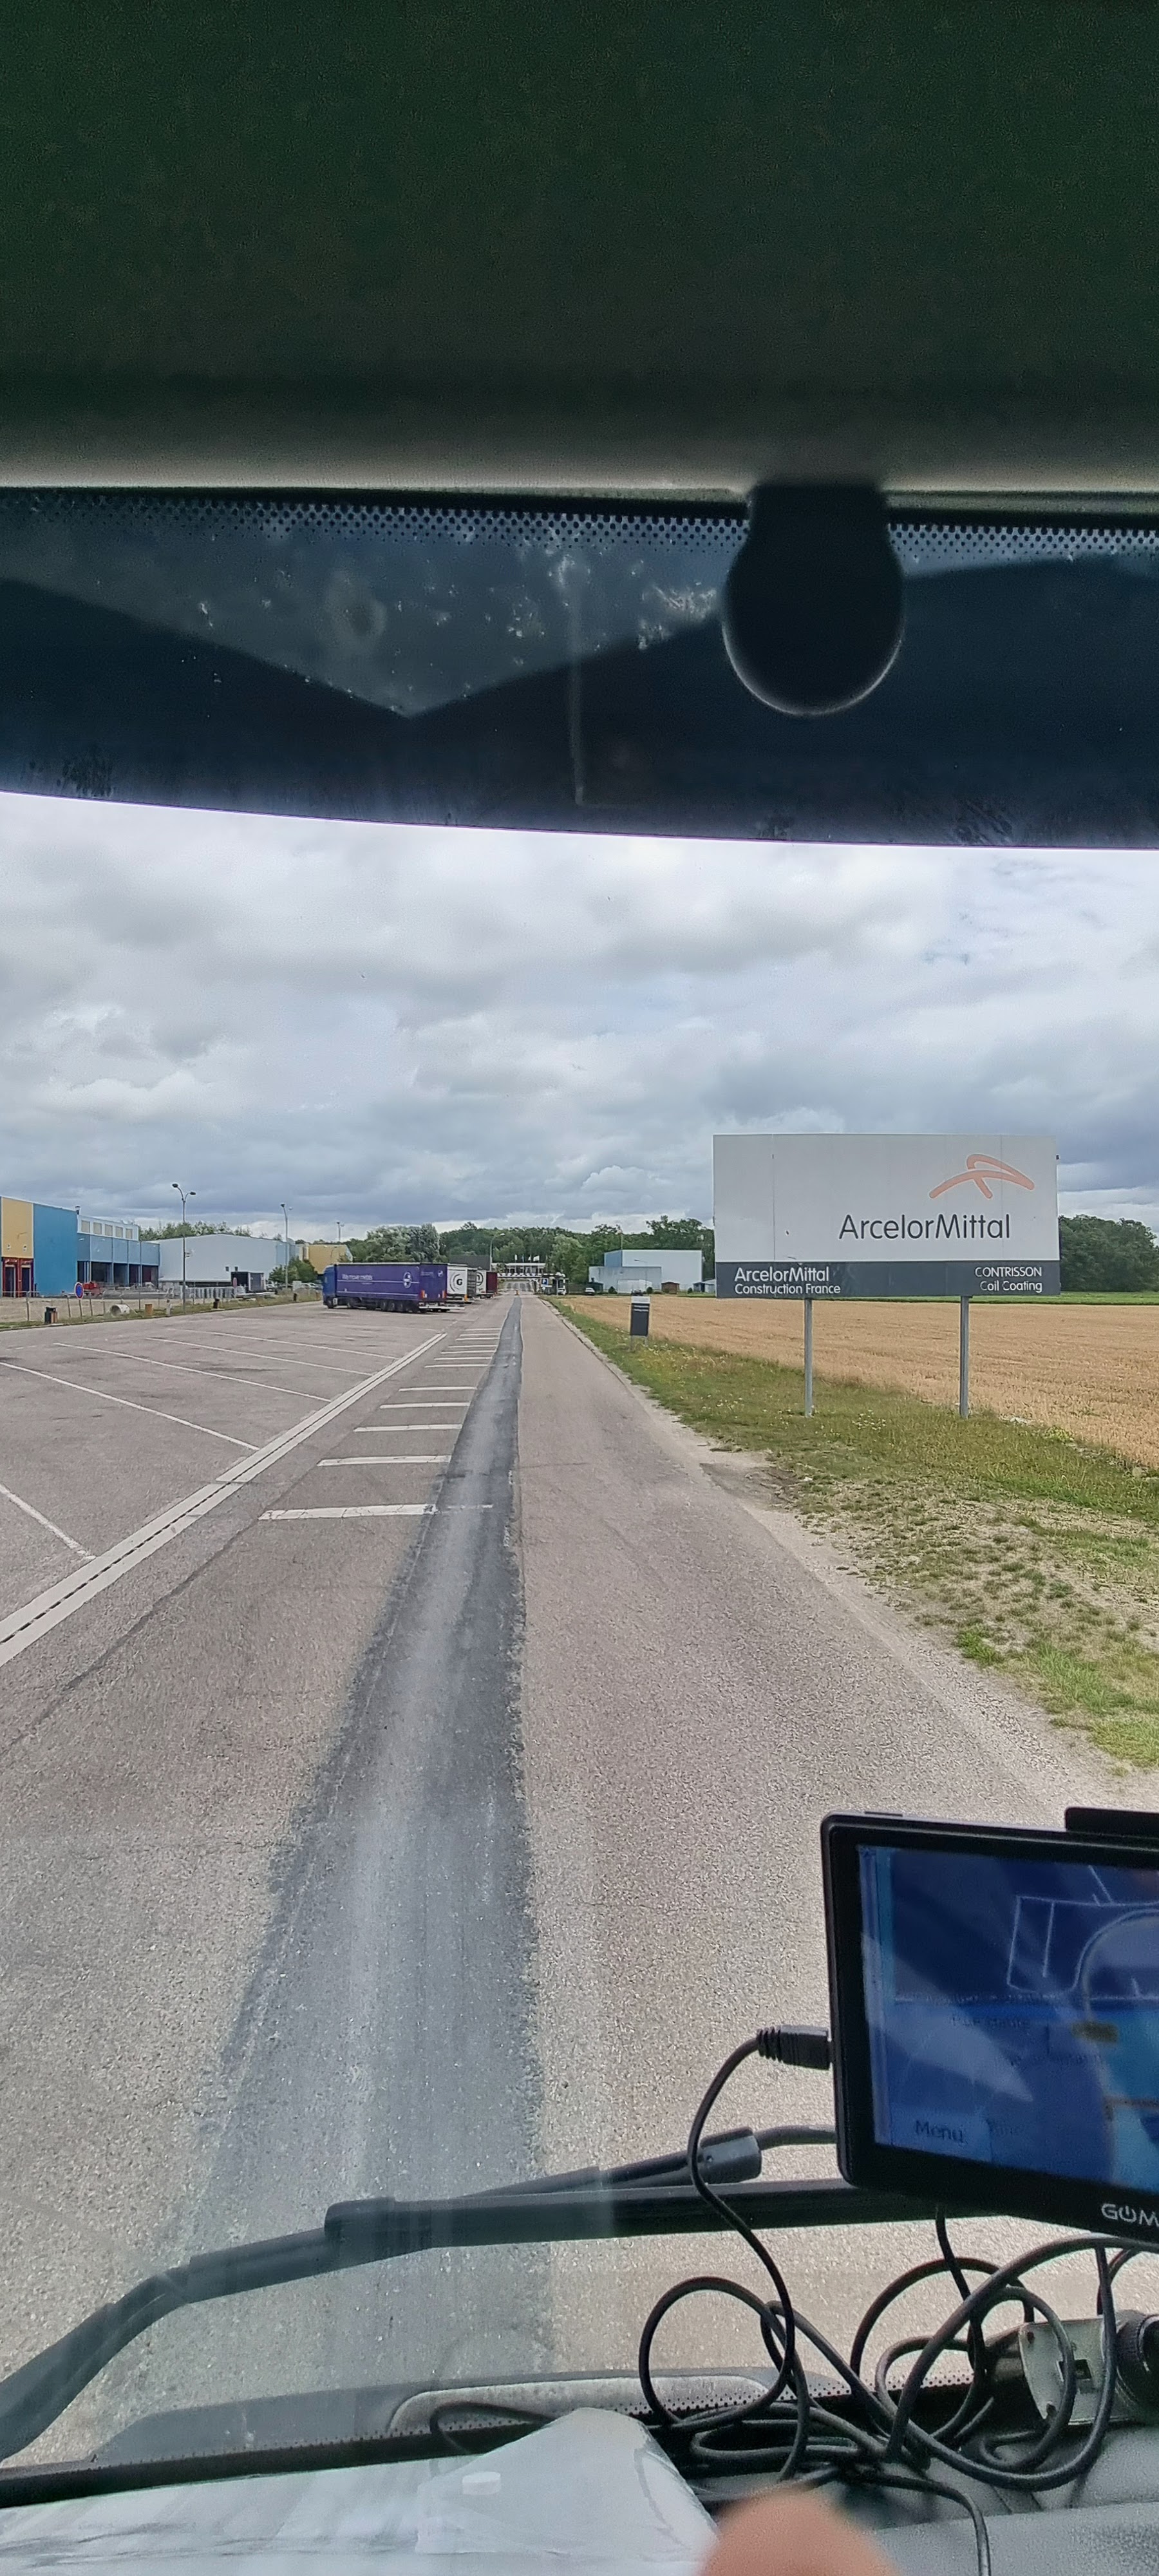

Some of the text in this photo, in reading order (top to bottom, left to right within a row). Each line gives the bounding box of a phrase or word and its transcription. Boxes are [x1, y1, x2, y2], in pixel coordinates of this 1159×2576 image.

[838, 1214, 1010, 1240] ArcelorMittal
[734, 1266, 829, 1282] ArcelorMittal
[975, 1267, 1042, 1277] CONTRISSON
[735, 1283, 841, 1294] Construction France
[980, 1280, 1042, 1293] Coil Coating
[915, 2119, 963, 2143] Menu
